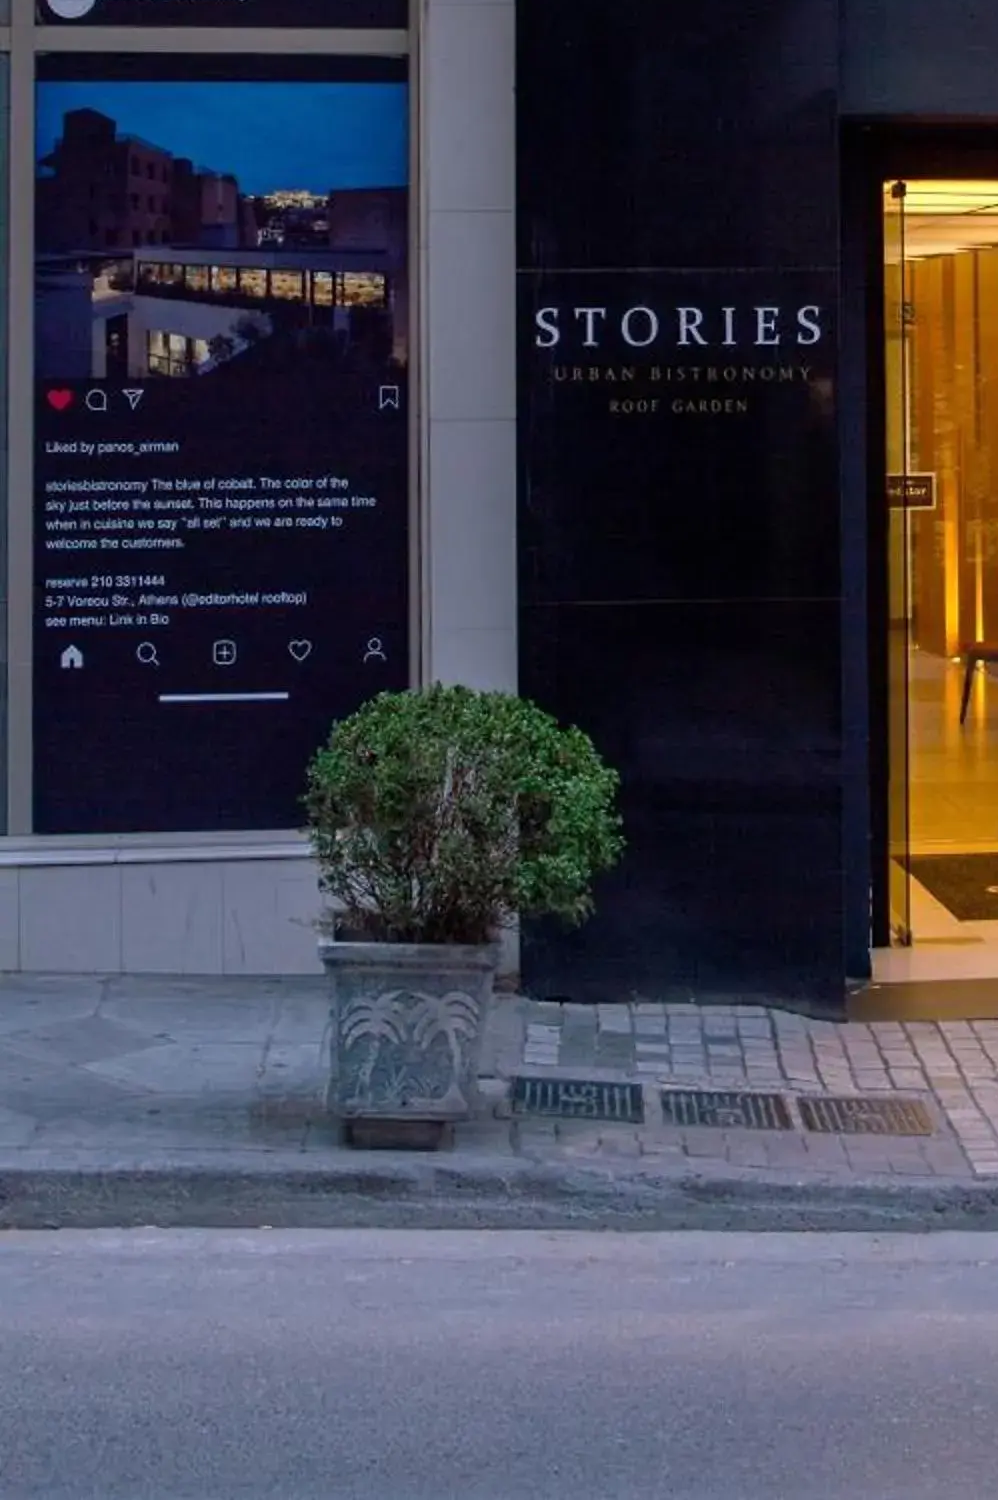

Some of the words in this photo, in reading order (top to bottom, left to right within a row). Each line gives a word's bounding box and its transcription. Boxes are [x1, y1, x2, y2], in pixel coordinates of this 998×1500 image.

[535, 304, 822, 347] STORIES
[553, 366, 636, 382] URBAN
[650, 365, 812, 383] BISTRONOMY
[609, 399, 660, 414] ROOF
[672, 398, 748, 414] GARDEN
[45, 441, 77, 453] Liked
[80, 441, 95, 456] by
[152, 478, 172, 490] The
[175, 479, 201, 491] blue
[204, 478, 215, 490] of
[260, 477, 282, 489] The
[284, 477, 314, 489] color
[316, 476, 328, 489] of
[330, 476, 349, 489] the
[45, 500, 66, 513] sky
[68, 500, 90, 512] just
[93, 500, 129, 511] before
[198, 497, 222, 509] This
[225, 498, 275, 511] happens
[277, 498, 293, 508] on
[296, 497, 315, 508] the
[317, 497, 348, 508] same
[351, 496, 377, 507] time
[45, 519, 77, 530] when
[79, 519, 91, 529] in
[138, 519, 153, 529] we
[158, 519, 177, 531] say
[229, 516, 252, 528] and
[253, 517, 271, 527] we
[274, 517, 292, 527] are
[296, 516, 328, 529] ready
[331, 516, 343, 527] to
[45, 538, 97, 549] welcome
[100, 537, 119, 548] the
[91, 575, 112, 587] 210
[45, 594, 65, 608] 5-7
[45, 616, 67, 627] see
[109, 613, 133, 625] Link
[136, 614, 147, 625] in
[150, 613, 169, 625] Bio
